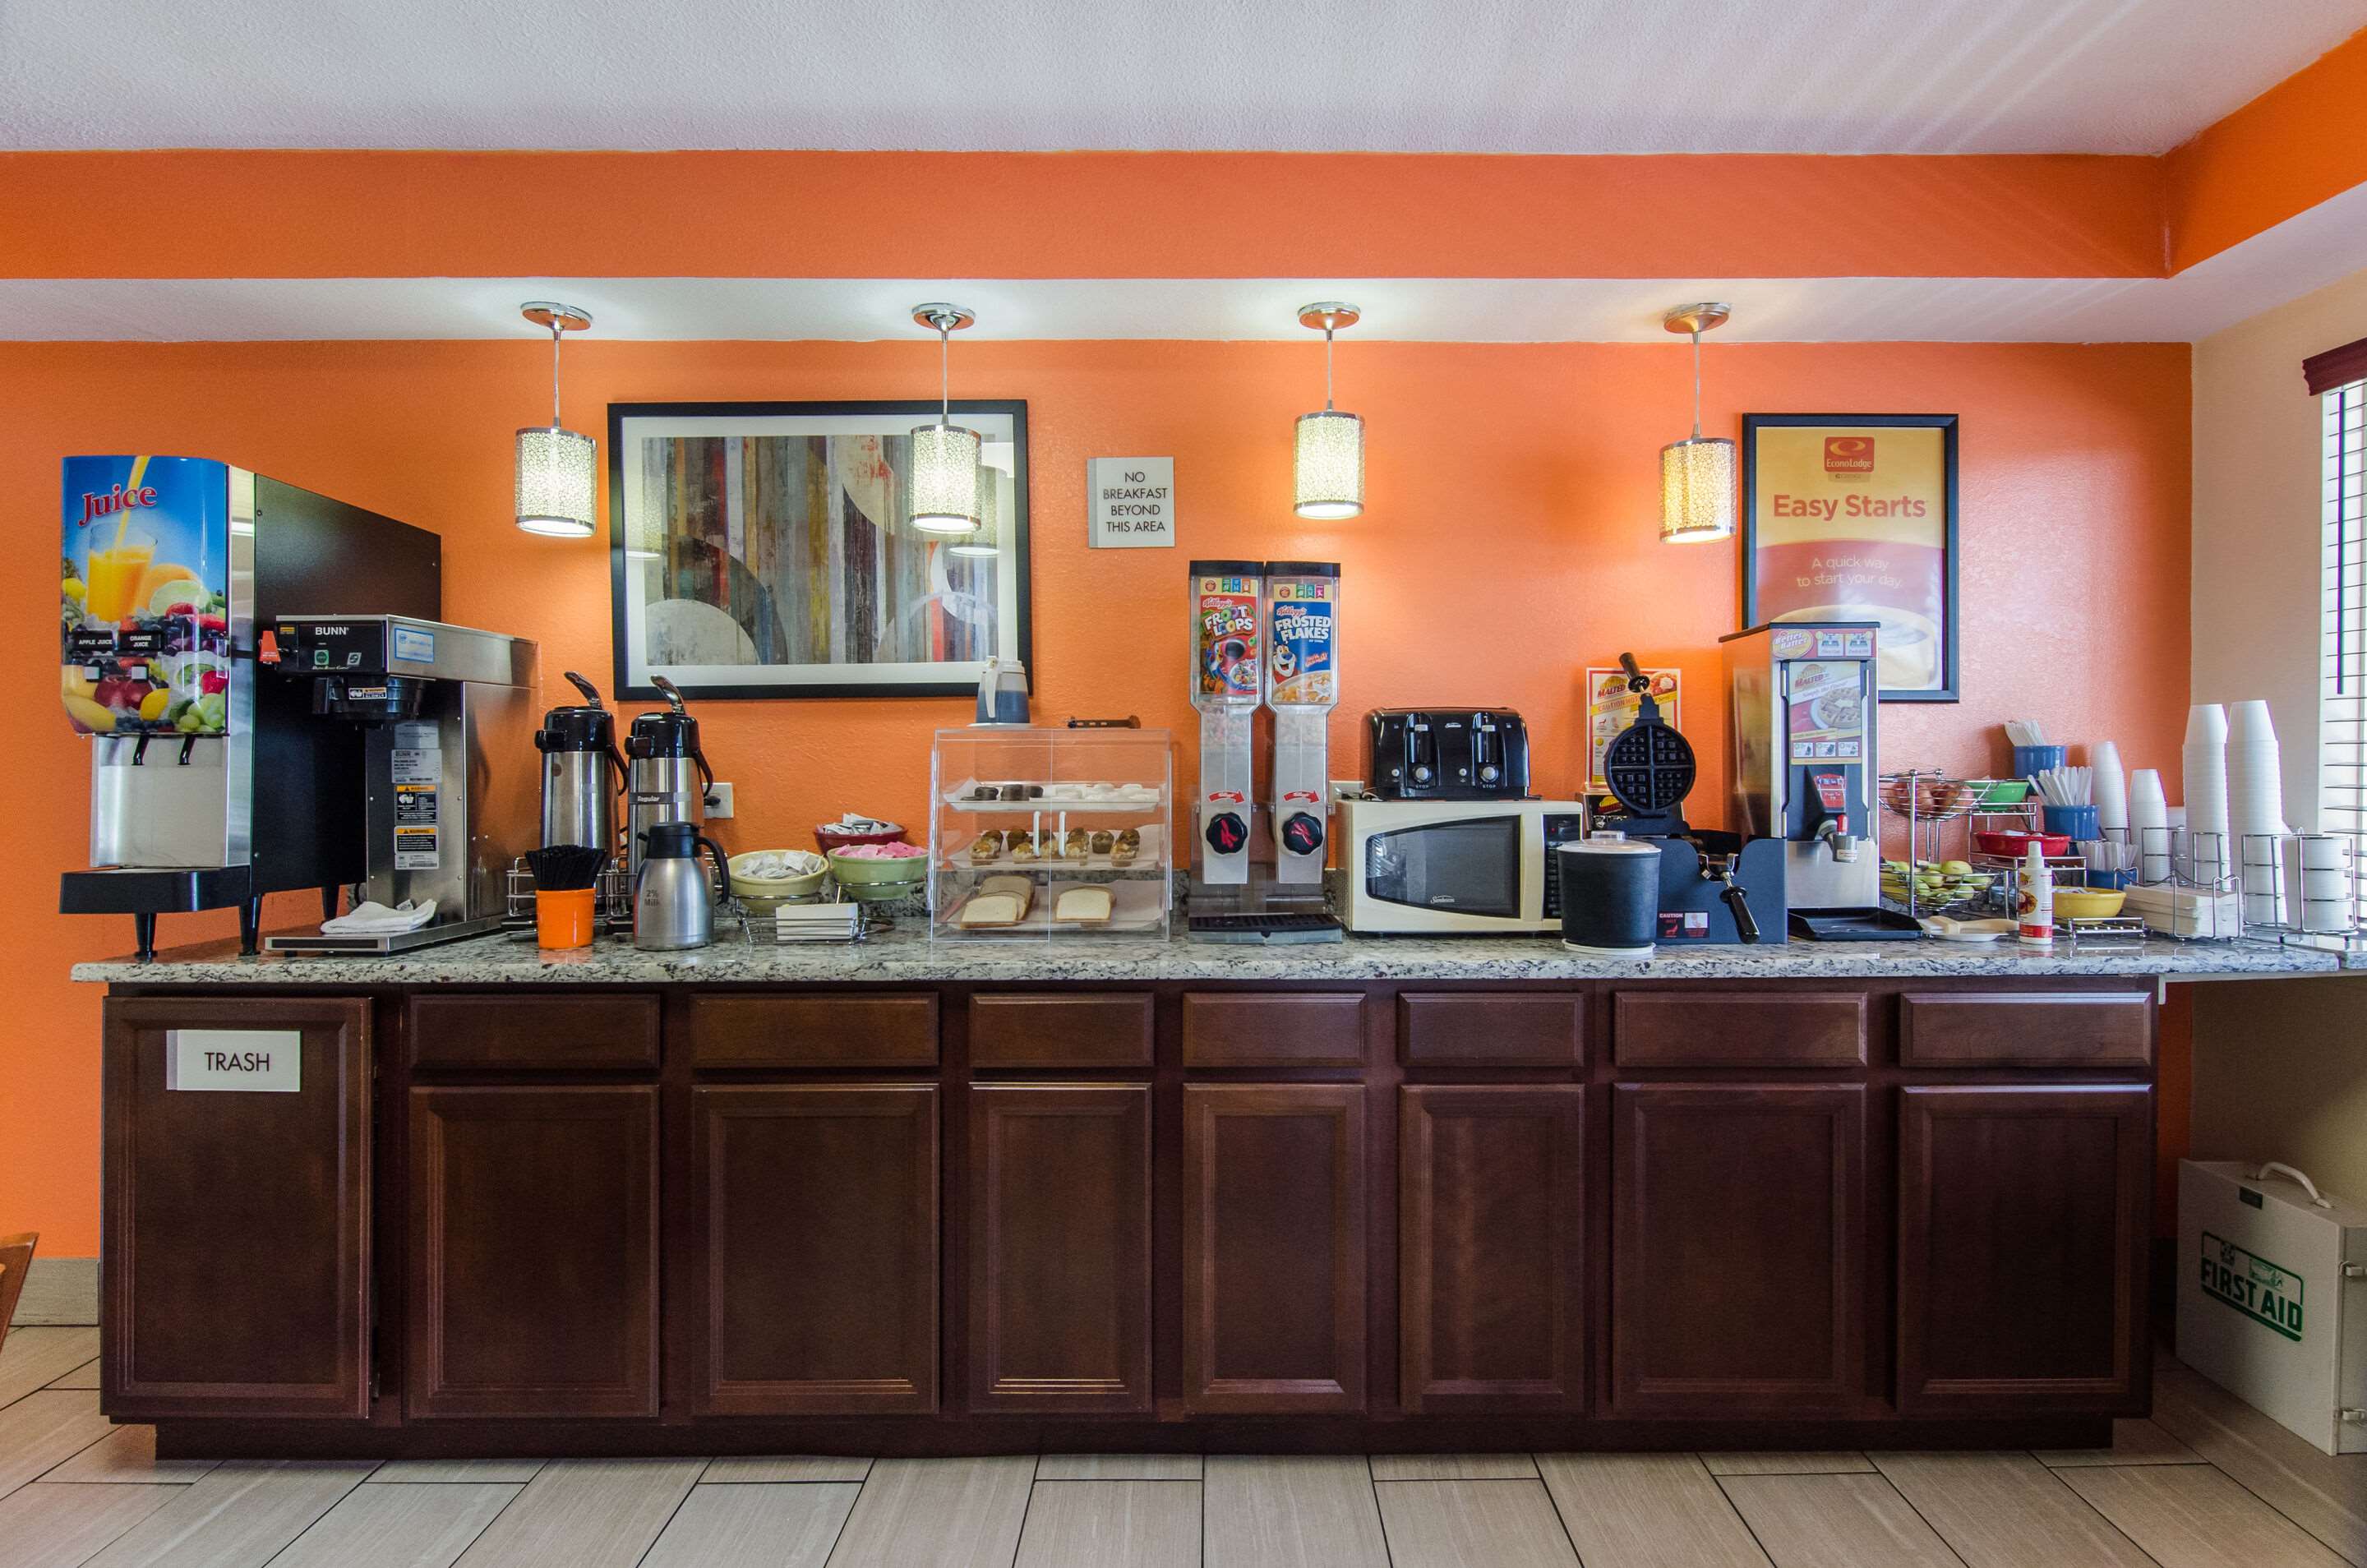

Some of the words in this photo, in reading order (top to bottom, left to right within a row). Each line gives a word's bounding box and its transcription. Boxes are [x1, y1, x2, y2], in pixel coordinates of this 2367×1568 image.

[1124, 472, 1146, 483] NO
[1103, 487, 1168, 500] BREAKFAST
[79, 483, 157, 527] Juice
[1111, 505, 1160, 516] BEYOND
[1773, 494, 1839, 521] Easy
[1845, 494, 1926, 518] Starts
[1105, 521, 1131, 533] THIS
[1134, 521, 1165, 533] AREA
[1811, 557, 1823, 570] A
[1826, 555, 1862, 570] quick
[1864, 558, 1889, 572] way
[1797, 576, 1811, 588] to
[1814, 573, 1843, 585] start
[1847, 574, 1875, 586] your
[1204, 605, 1248, 631] FROOT
[1275, 615, 1331, 631] FROSTED
[315, 626, 347, 636] BUNN
[1213, 618, 1253, 637] LOOPS
[1280, 627, 1329, 643] FLAKES
[1598, 698, 1626, 712] CAUTION
[204, 1052, 270, 1072] TRASH
[2202, 1257, 2257, 1308] FIRST
[2261, 1289, 2302, 1333] AID
